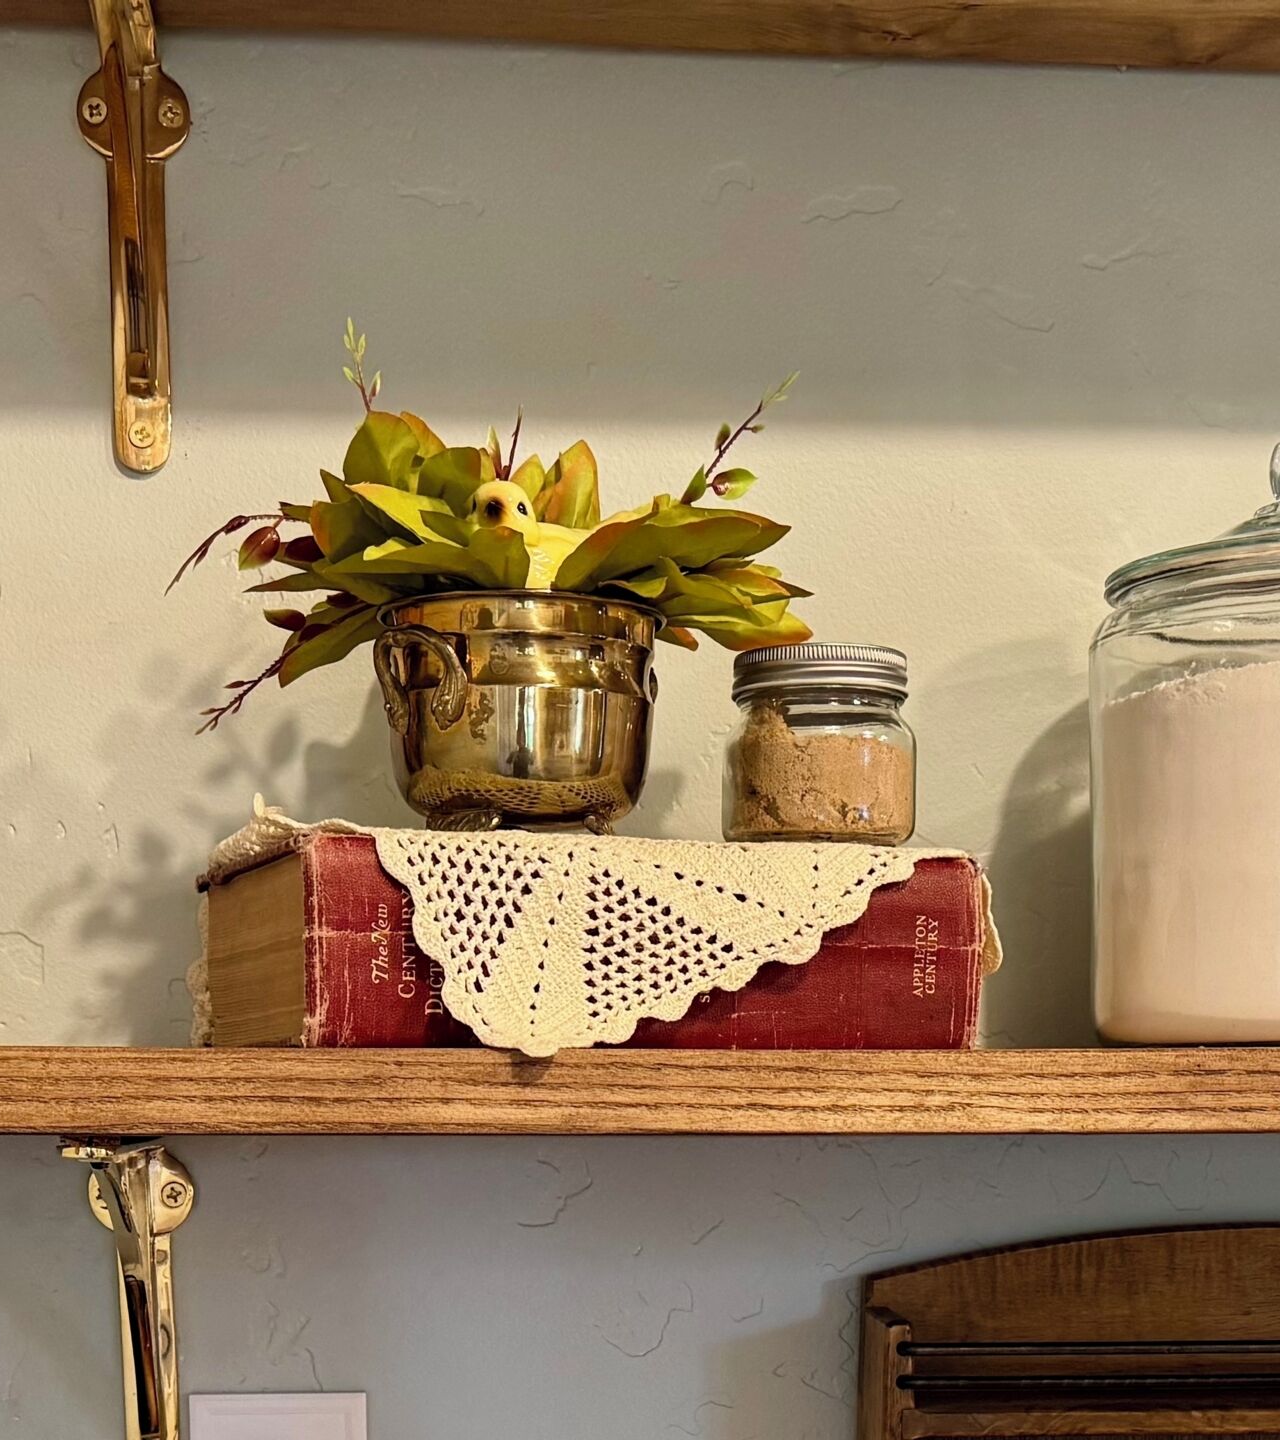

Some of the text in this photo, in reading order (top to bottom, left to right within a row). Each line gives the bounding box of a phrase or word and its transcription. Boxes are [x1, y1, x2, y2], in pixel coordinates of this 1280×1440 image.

[371, 903, 391, 984] The New
[912, 914, 927, 998] APPLETON
[924, 918, 939, 995] CENTURY
